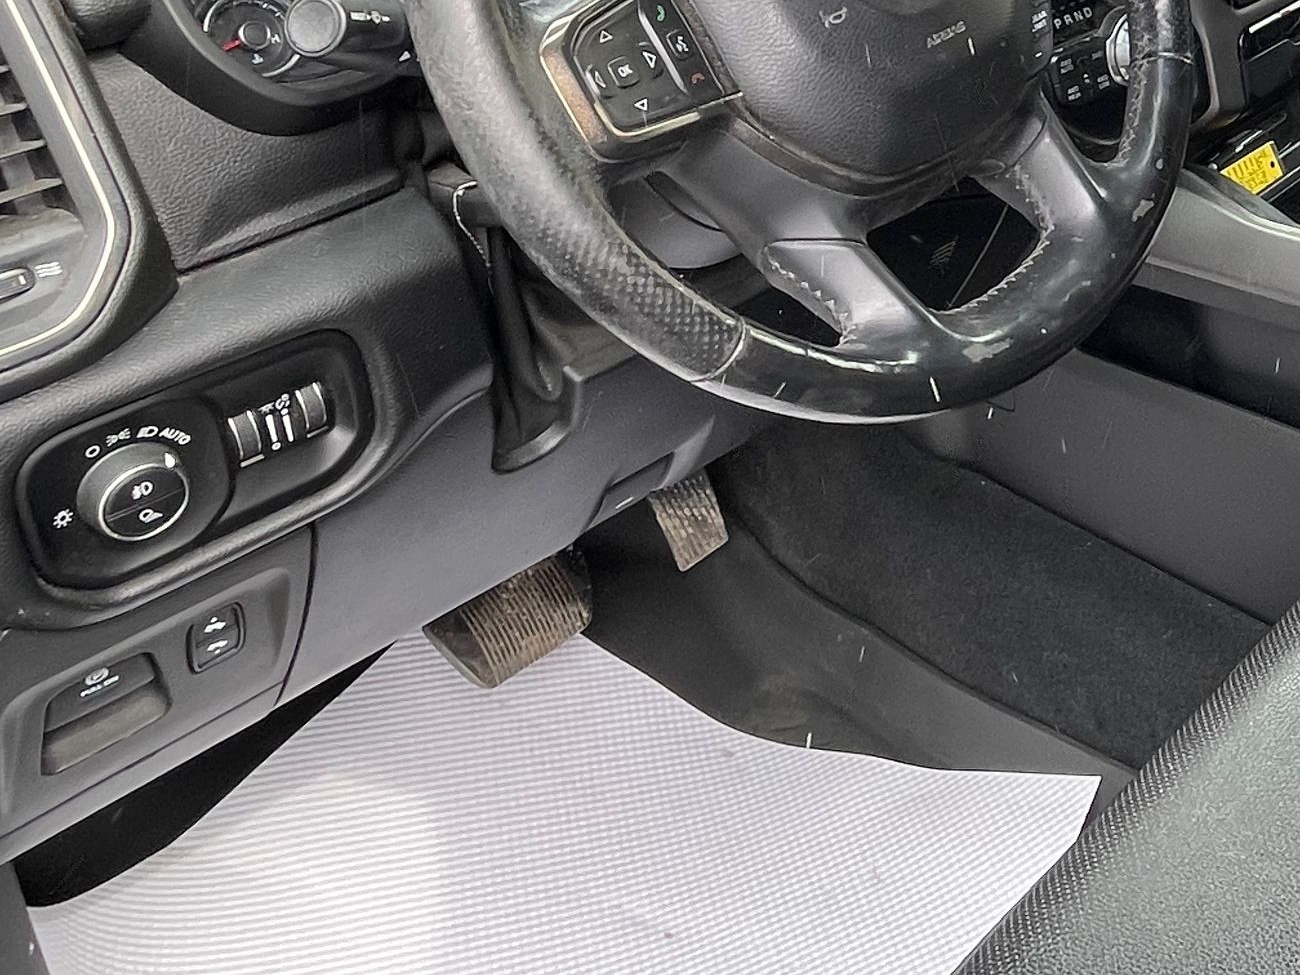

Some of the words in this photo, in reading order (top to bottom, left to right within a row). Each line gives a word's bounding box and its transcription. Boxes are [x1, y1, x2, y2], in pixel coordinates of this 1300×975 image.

[1053, 18, 1062, 30] P
[1074, 11, 1083, 22] N
[1083, 7, 1093, 18] D
[617, 63, 634, 78] OK
[159, 427, 191, 445] AUTO
